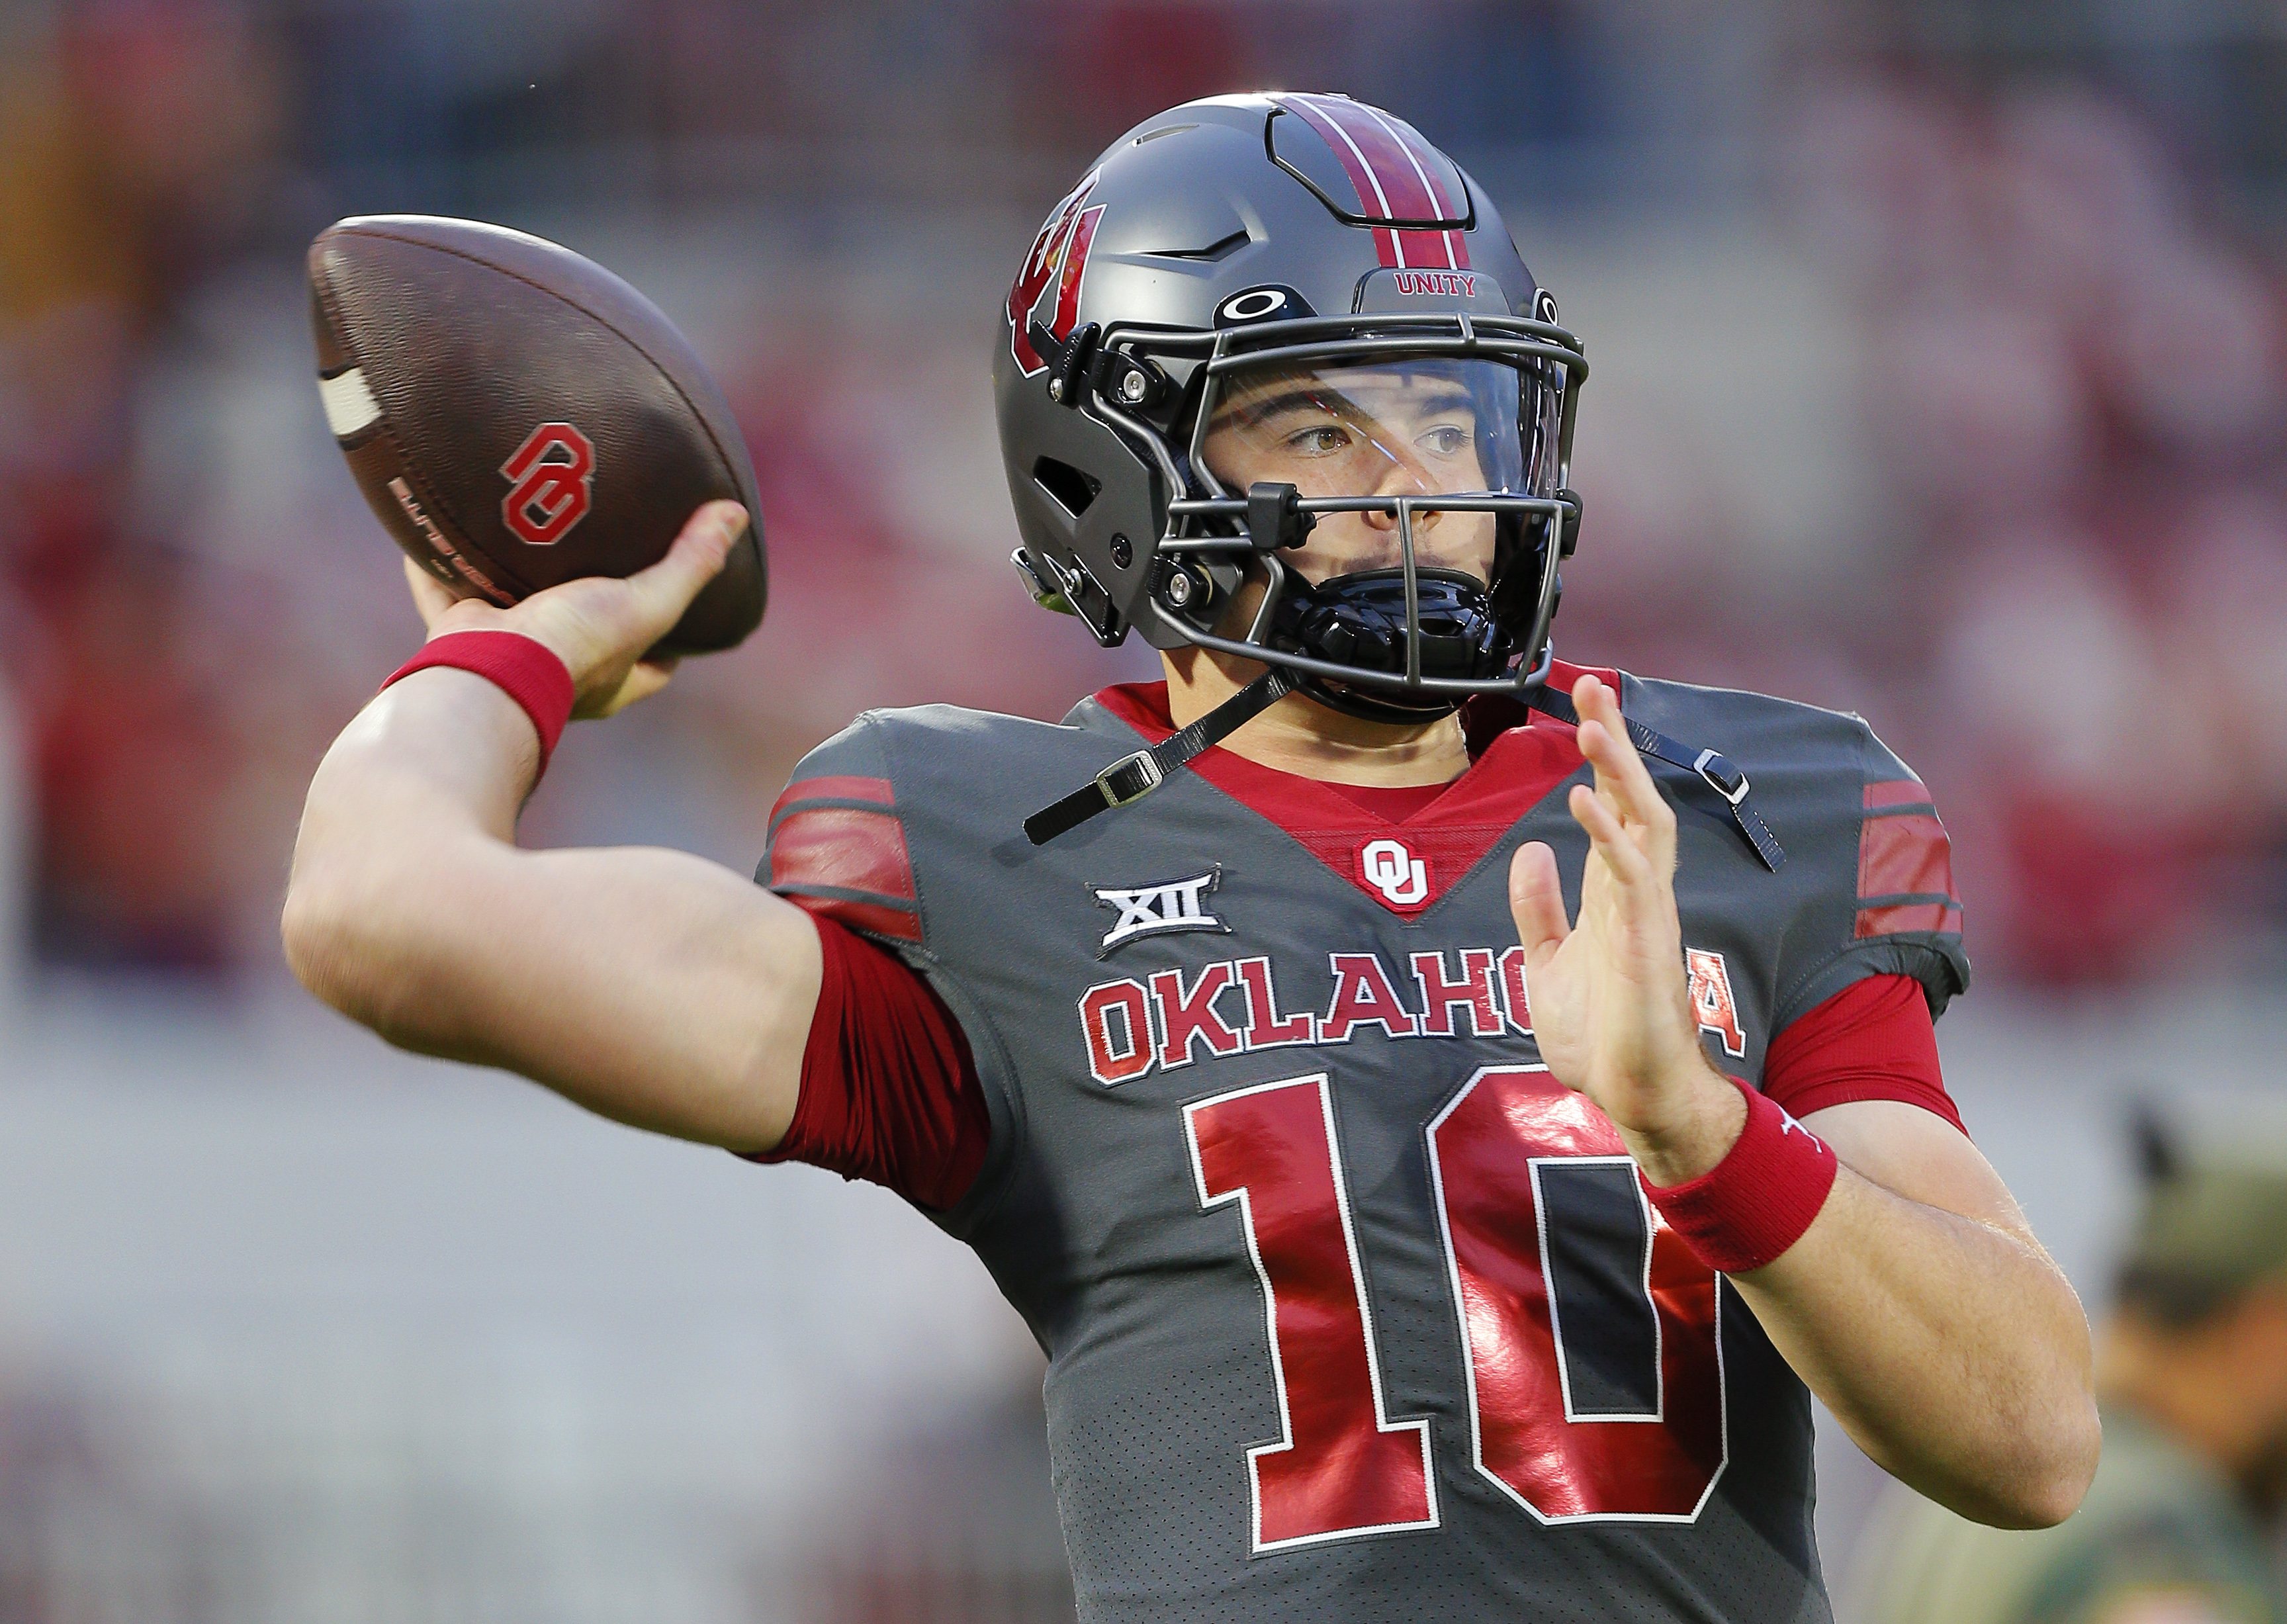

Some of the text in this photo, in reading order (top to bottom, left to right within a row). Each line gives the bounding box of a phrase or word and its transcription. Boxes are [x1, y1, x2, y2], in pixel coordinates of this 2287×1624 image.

[1393, 272, 1476, 298] UNITY
[1361, 839, 1429, 905] OU
[1095, 873, 1220, 948] XII
[1077, 946, 1746, 1087] OKLAHA
[1181, 1063, 1730, 1556] 10
